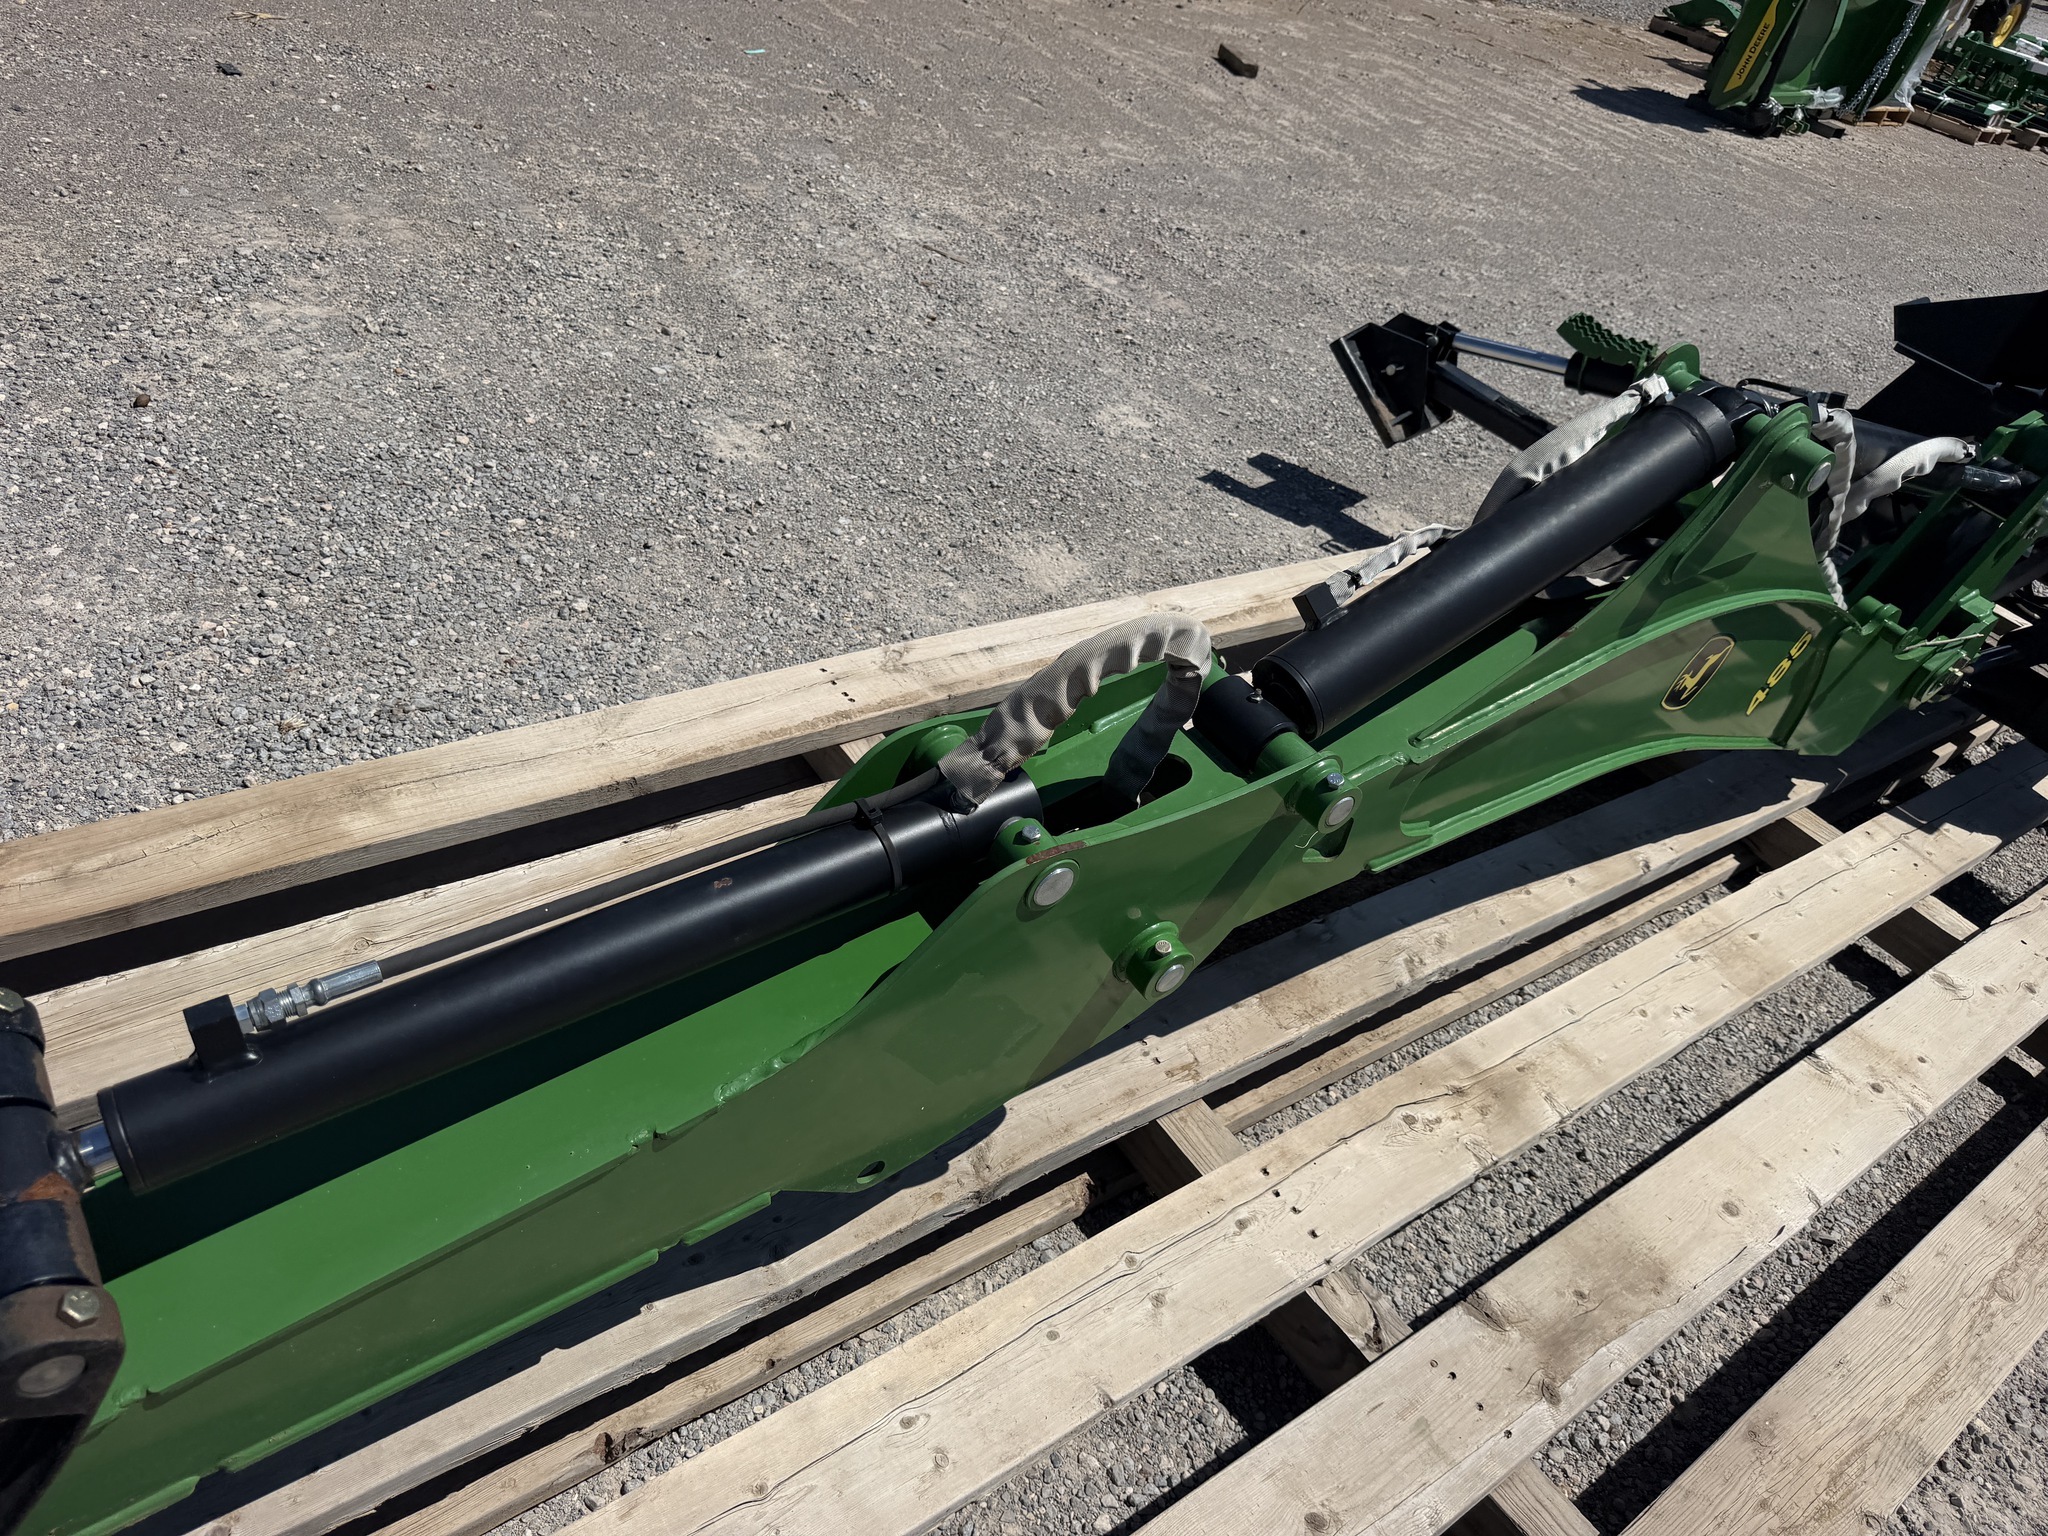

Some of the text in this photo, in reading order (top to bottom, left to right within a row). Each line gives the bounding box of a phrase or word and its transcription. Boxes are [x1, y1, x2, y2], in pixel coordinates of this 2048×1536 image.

[1737, 22, 1770, 79] JOHN DEERE
[1745, 630, 1813, 716] 485
